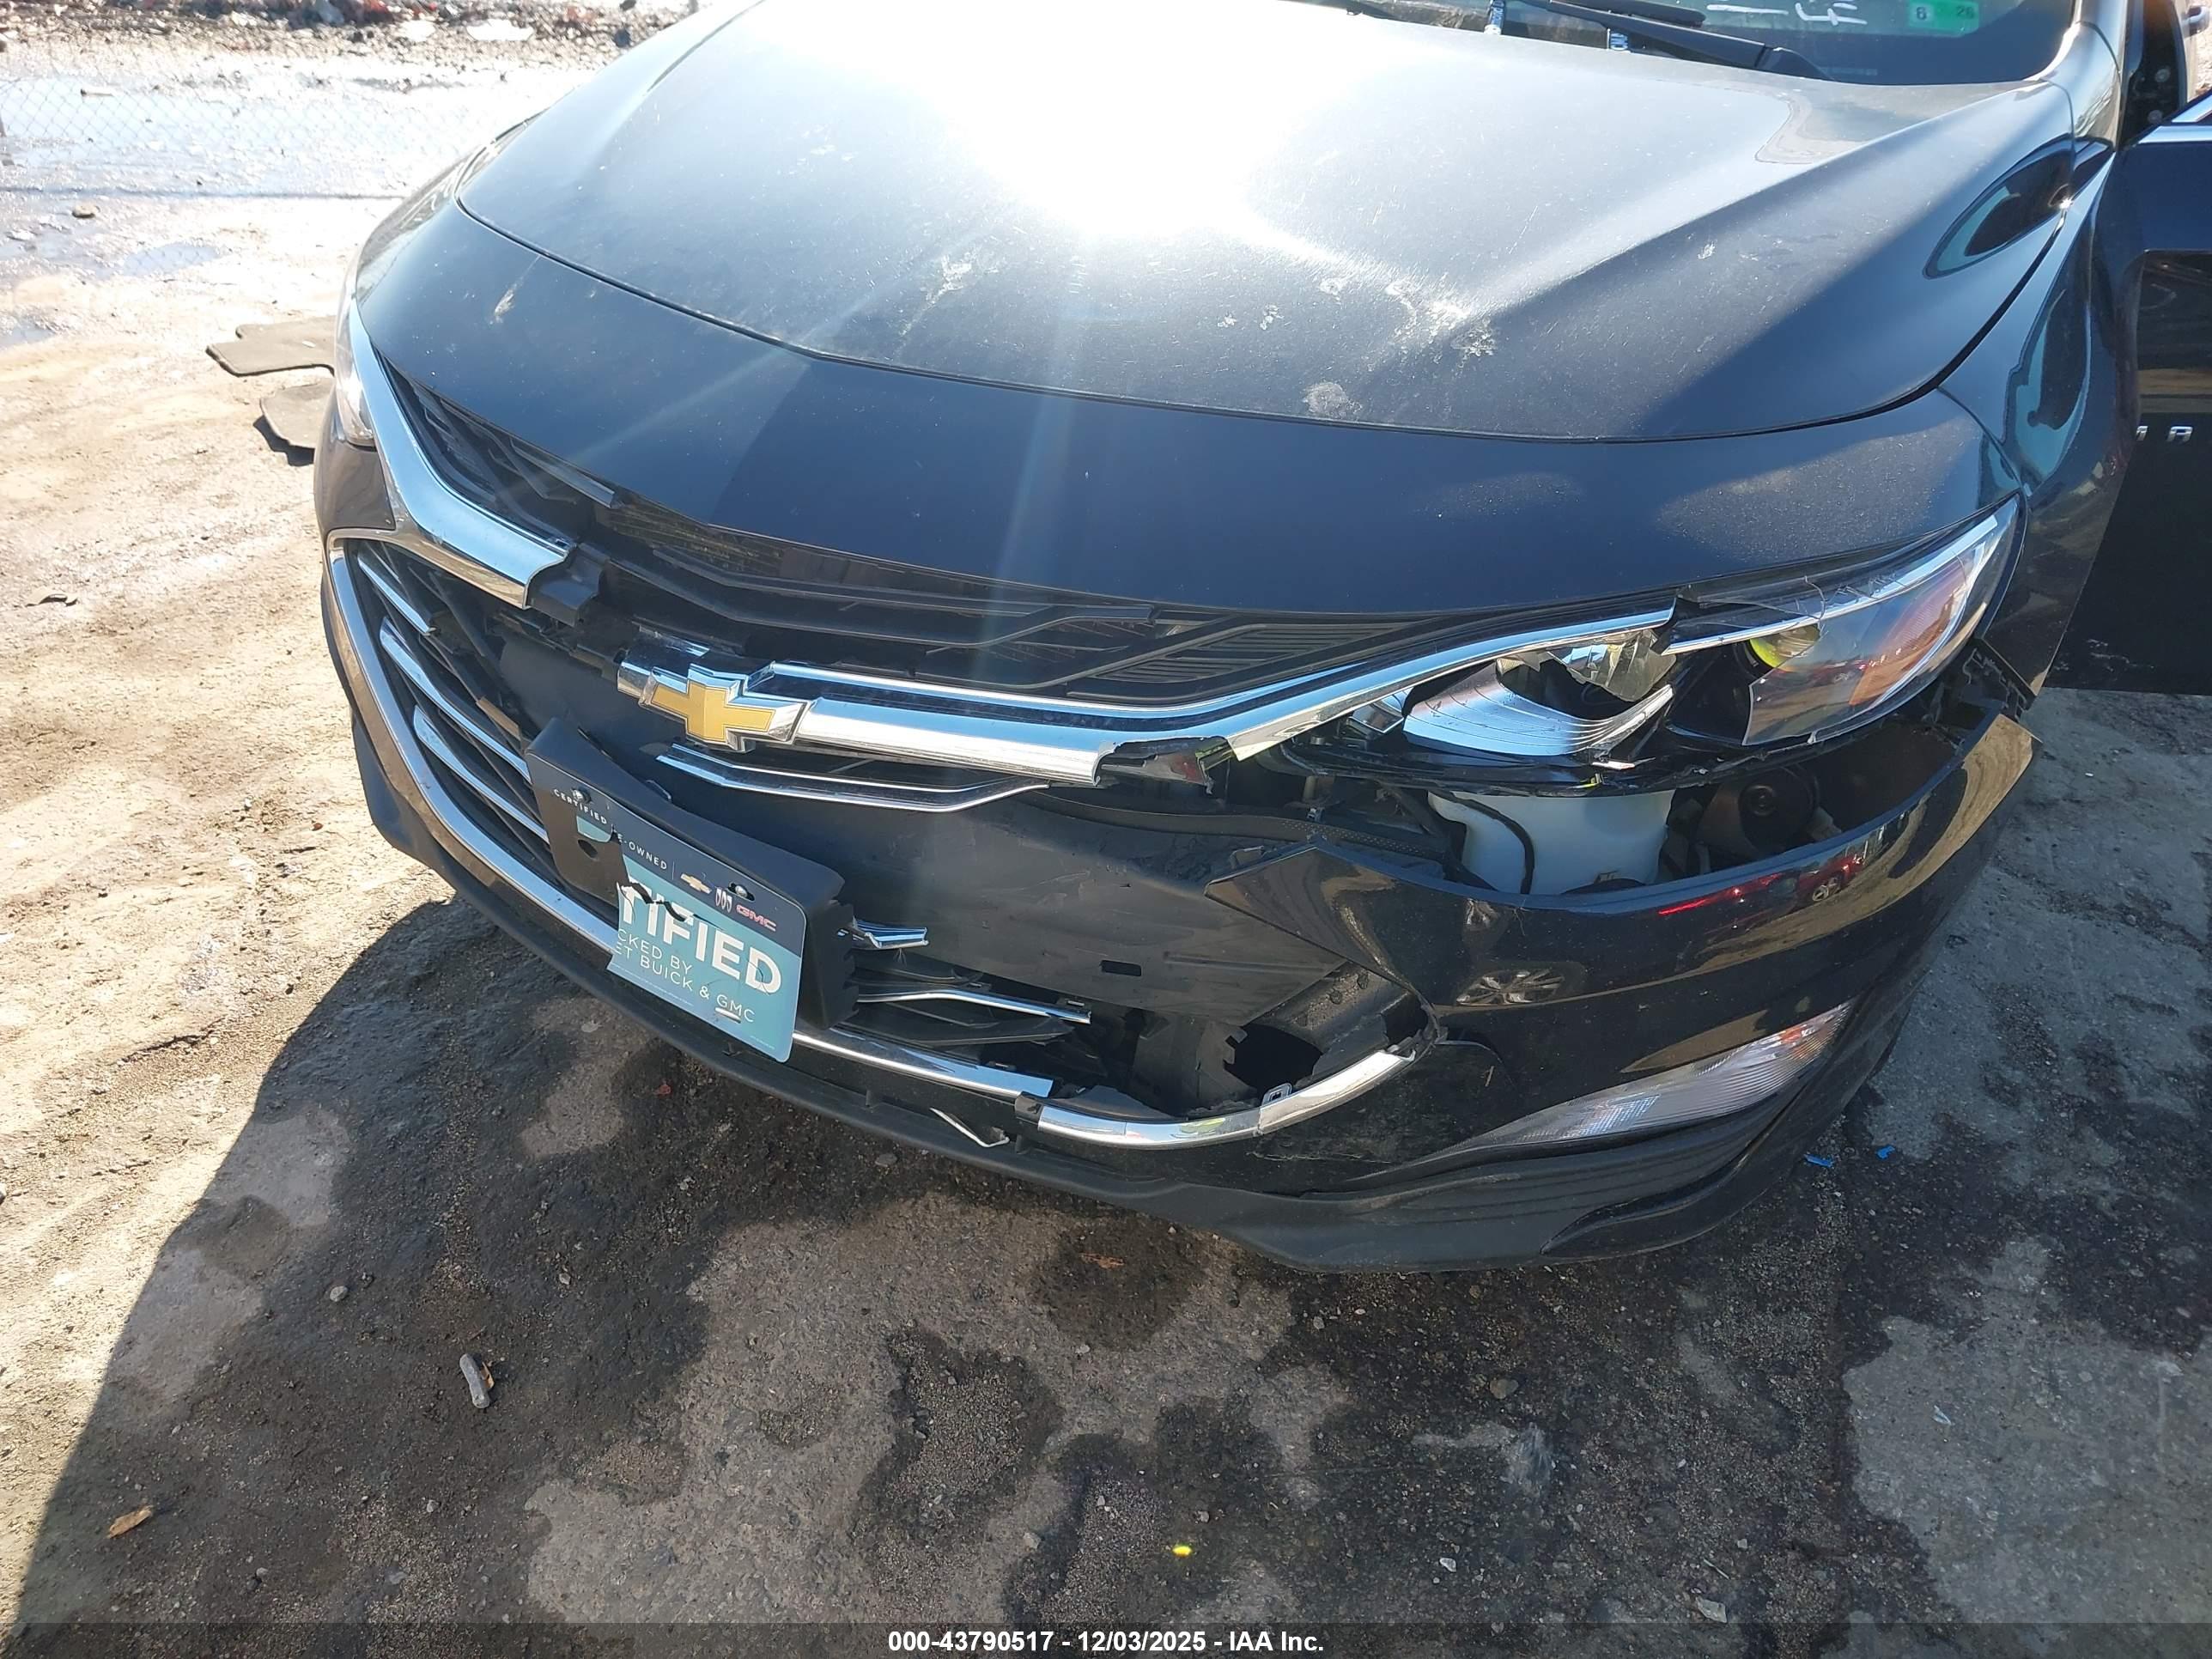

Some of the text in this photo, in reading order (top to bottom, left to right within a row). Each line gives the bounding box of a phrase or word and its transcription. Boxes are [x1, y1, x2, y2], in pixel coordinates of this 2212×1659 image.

[554, 788, 607, 824] CERTIFIED
[736, 904, 777, 933] GMC
[671, 955, 692, 975] BY
[641, 955, 694, 992] BUICK
[699, 986, 709, 1000] &
[716, 994, 756, 1024] GMC
